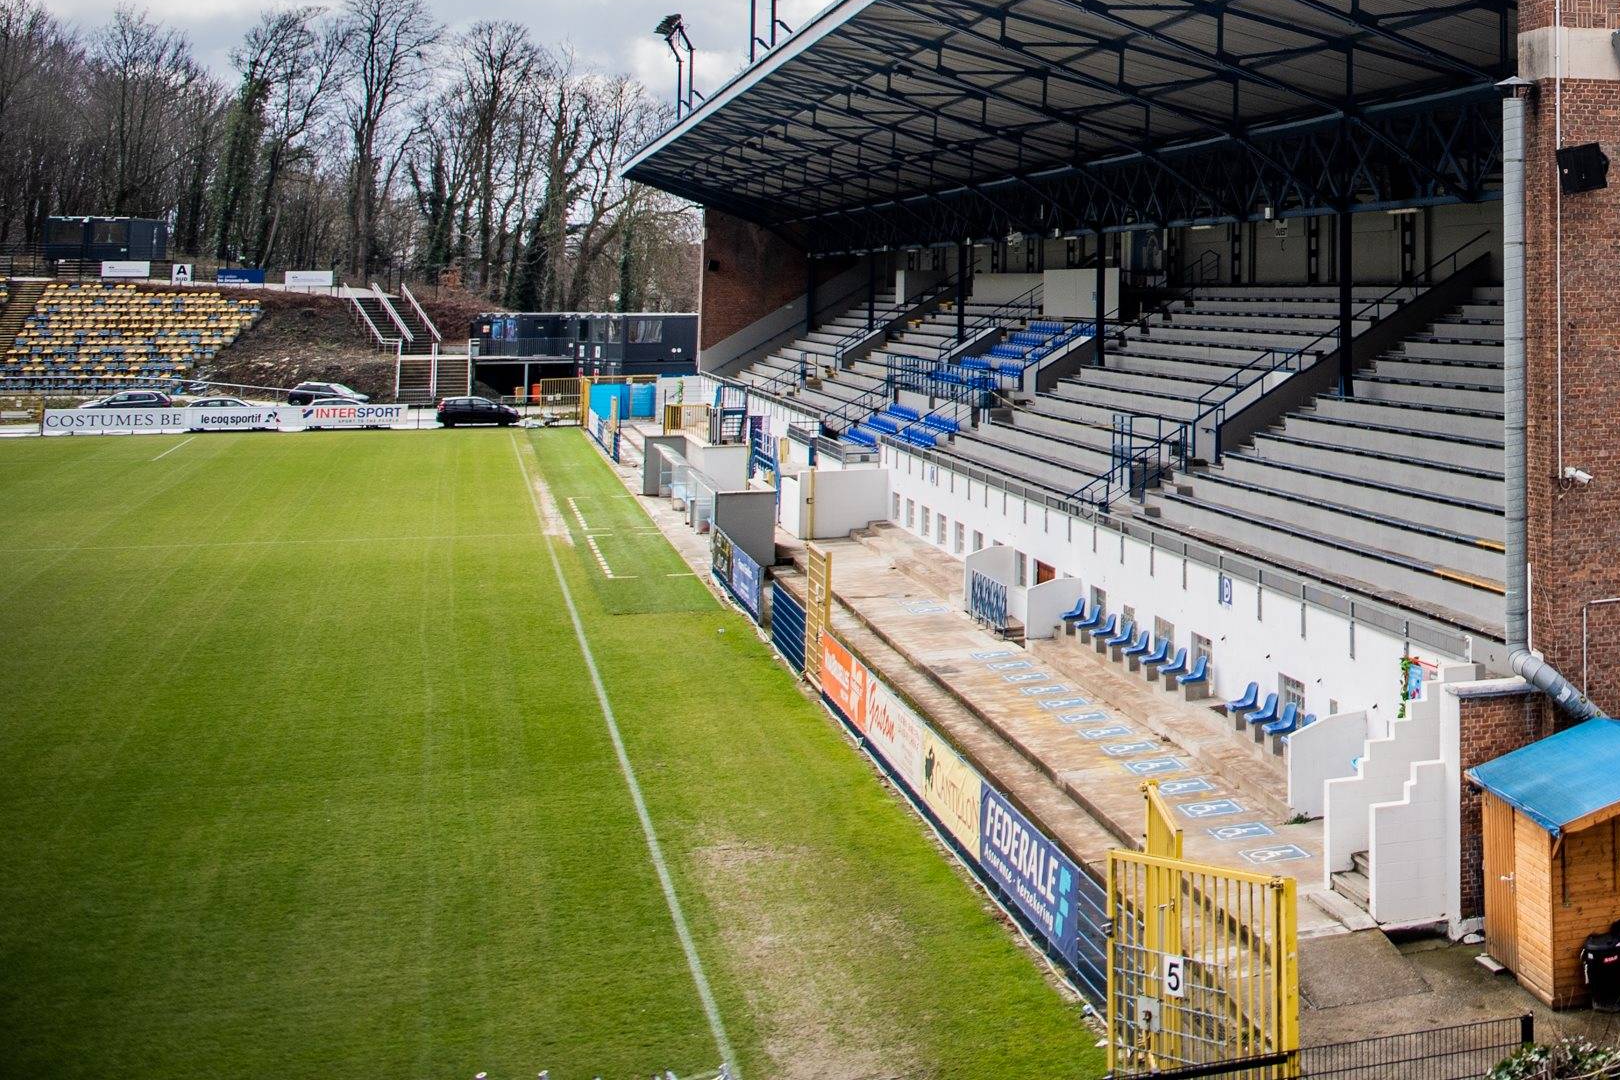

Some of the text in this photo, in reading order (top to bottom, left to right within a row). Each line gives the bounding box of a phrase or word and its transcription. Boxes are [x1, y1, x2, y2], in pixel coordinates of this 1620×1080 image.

[176, 265, 187, 275] A
[46, 413, 182, 428] COSTUMES BE
[201, 413, 262, 426] le coq sportif
[315, 407, 402, 419] INTERSPORT
[985, 796, 1060, 905] FEDERALE
[984, 842, 1054, 932] Assurance Verzekering
[1168, 962, 1180, 991] 5
